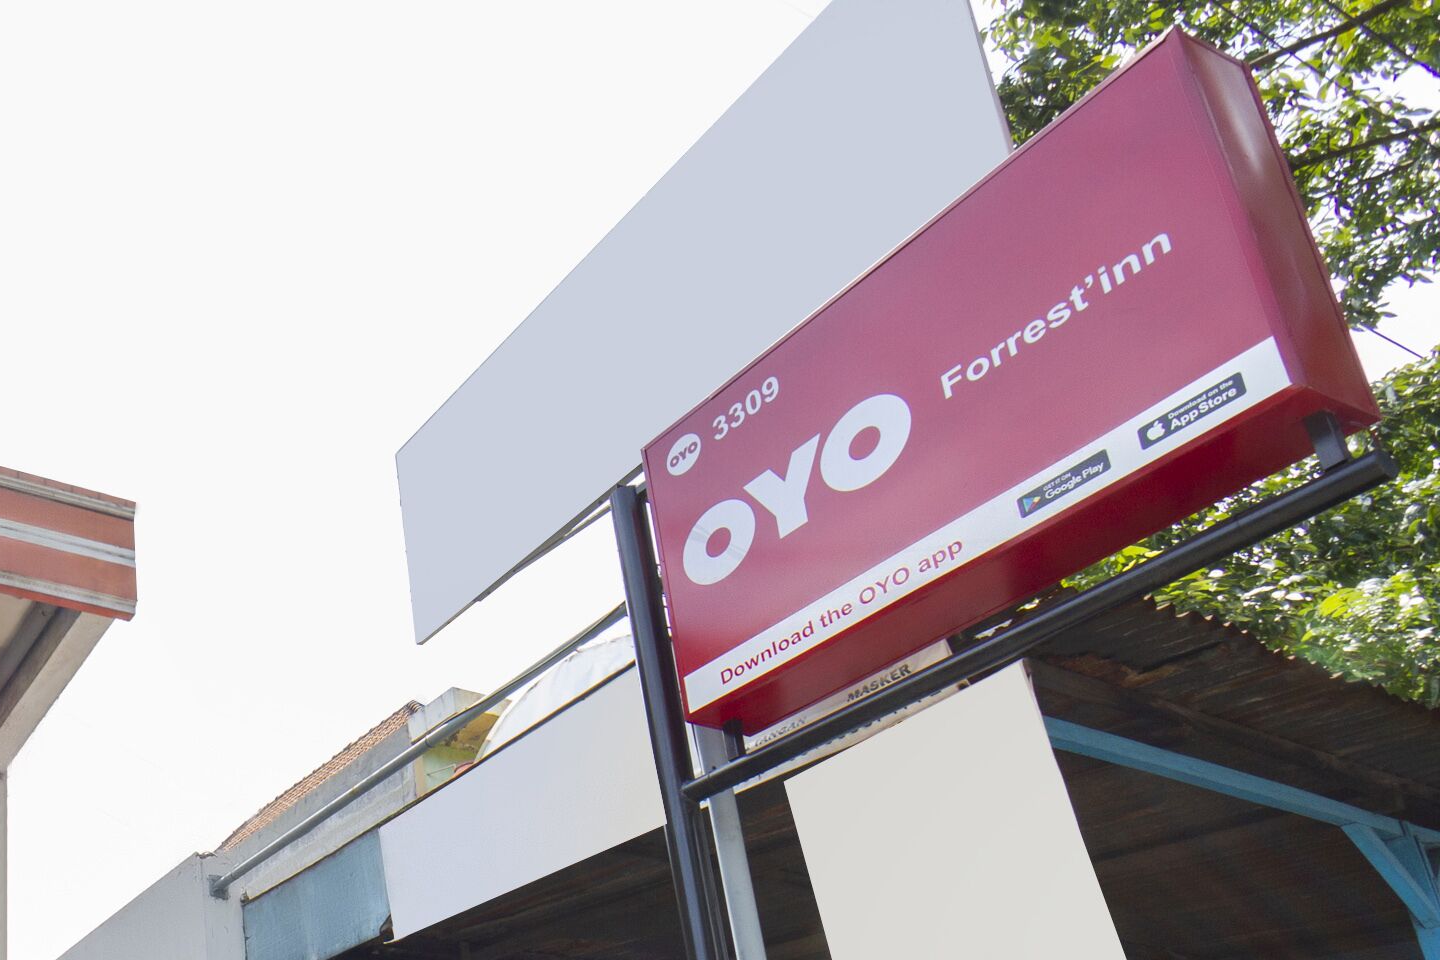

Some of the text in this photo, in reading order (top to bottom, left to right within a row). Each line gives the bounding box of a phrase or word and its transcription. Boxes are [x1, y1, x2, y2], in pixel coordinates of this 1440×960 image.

[940, 232, 1173, 399] Forrest'inn
[669, 376, 779, 468] OYO 3309
[1167, 380, 1234, 419] Download on the
[1170, 388, 1237, 430] App Store
[682, 394, 912, 586] OYO
[1045, 462, 1104, 499] Google Play
[720, 540, 963, 685] Download the OYO app
